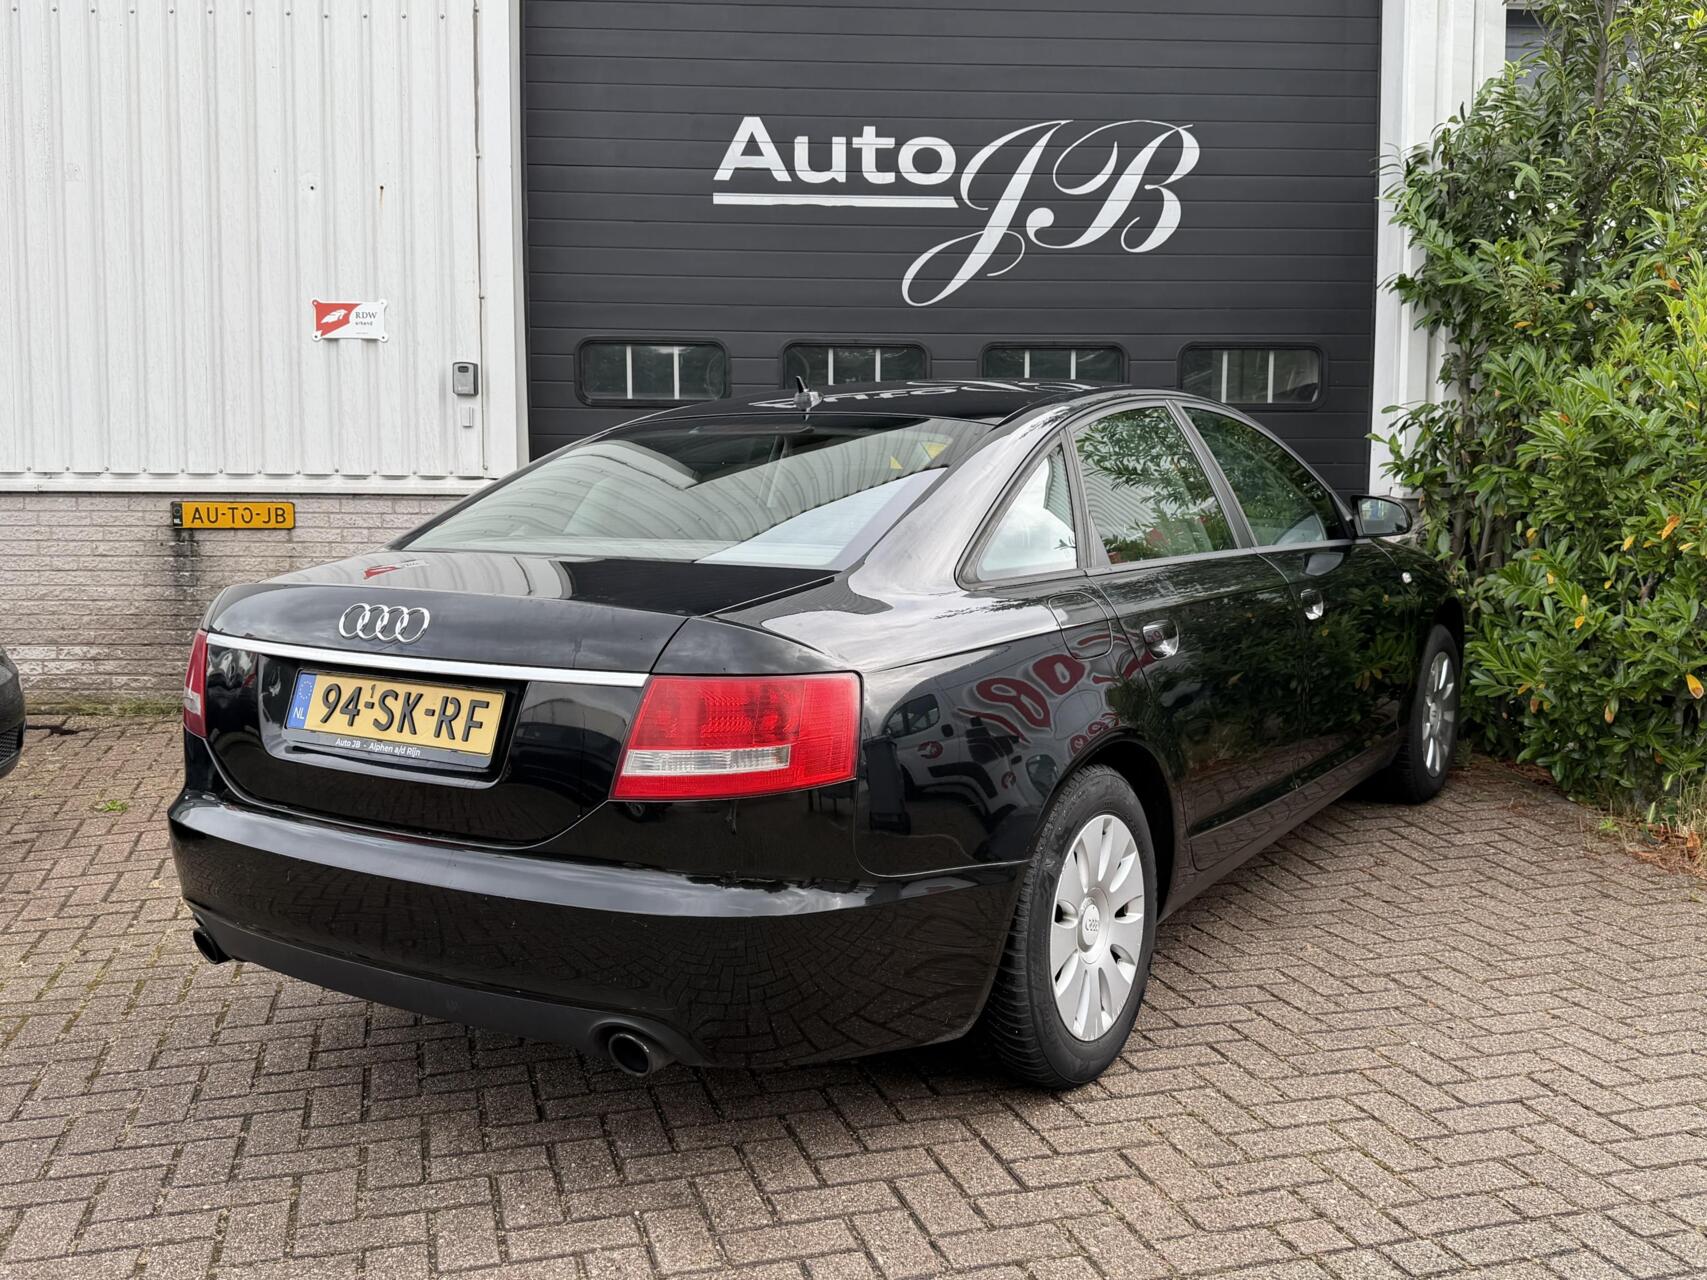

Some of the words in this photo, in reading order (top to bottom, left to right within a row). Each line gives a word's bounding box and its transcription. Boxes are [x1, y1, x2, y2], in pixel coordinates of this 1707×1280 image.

[713, 116, 956, 185] Auto
[902, 119, 1200, 306] JB
[191, 506, 287, 524] AU-TO-JB
[292, 706, 305, 720] NL
[320, 682, 491, 743] 94-SK-RF
[335, 738, 351, 747] Auto
[351, 740, 361, 749] JB
[368, 742, 394, 754] Alphen
[394, 746, 406, 757] a/d
[406, 747, 421, 758] Rijn
